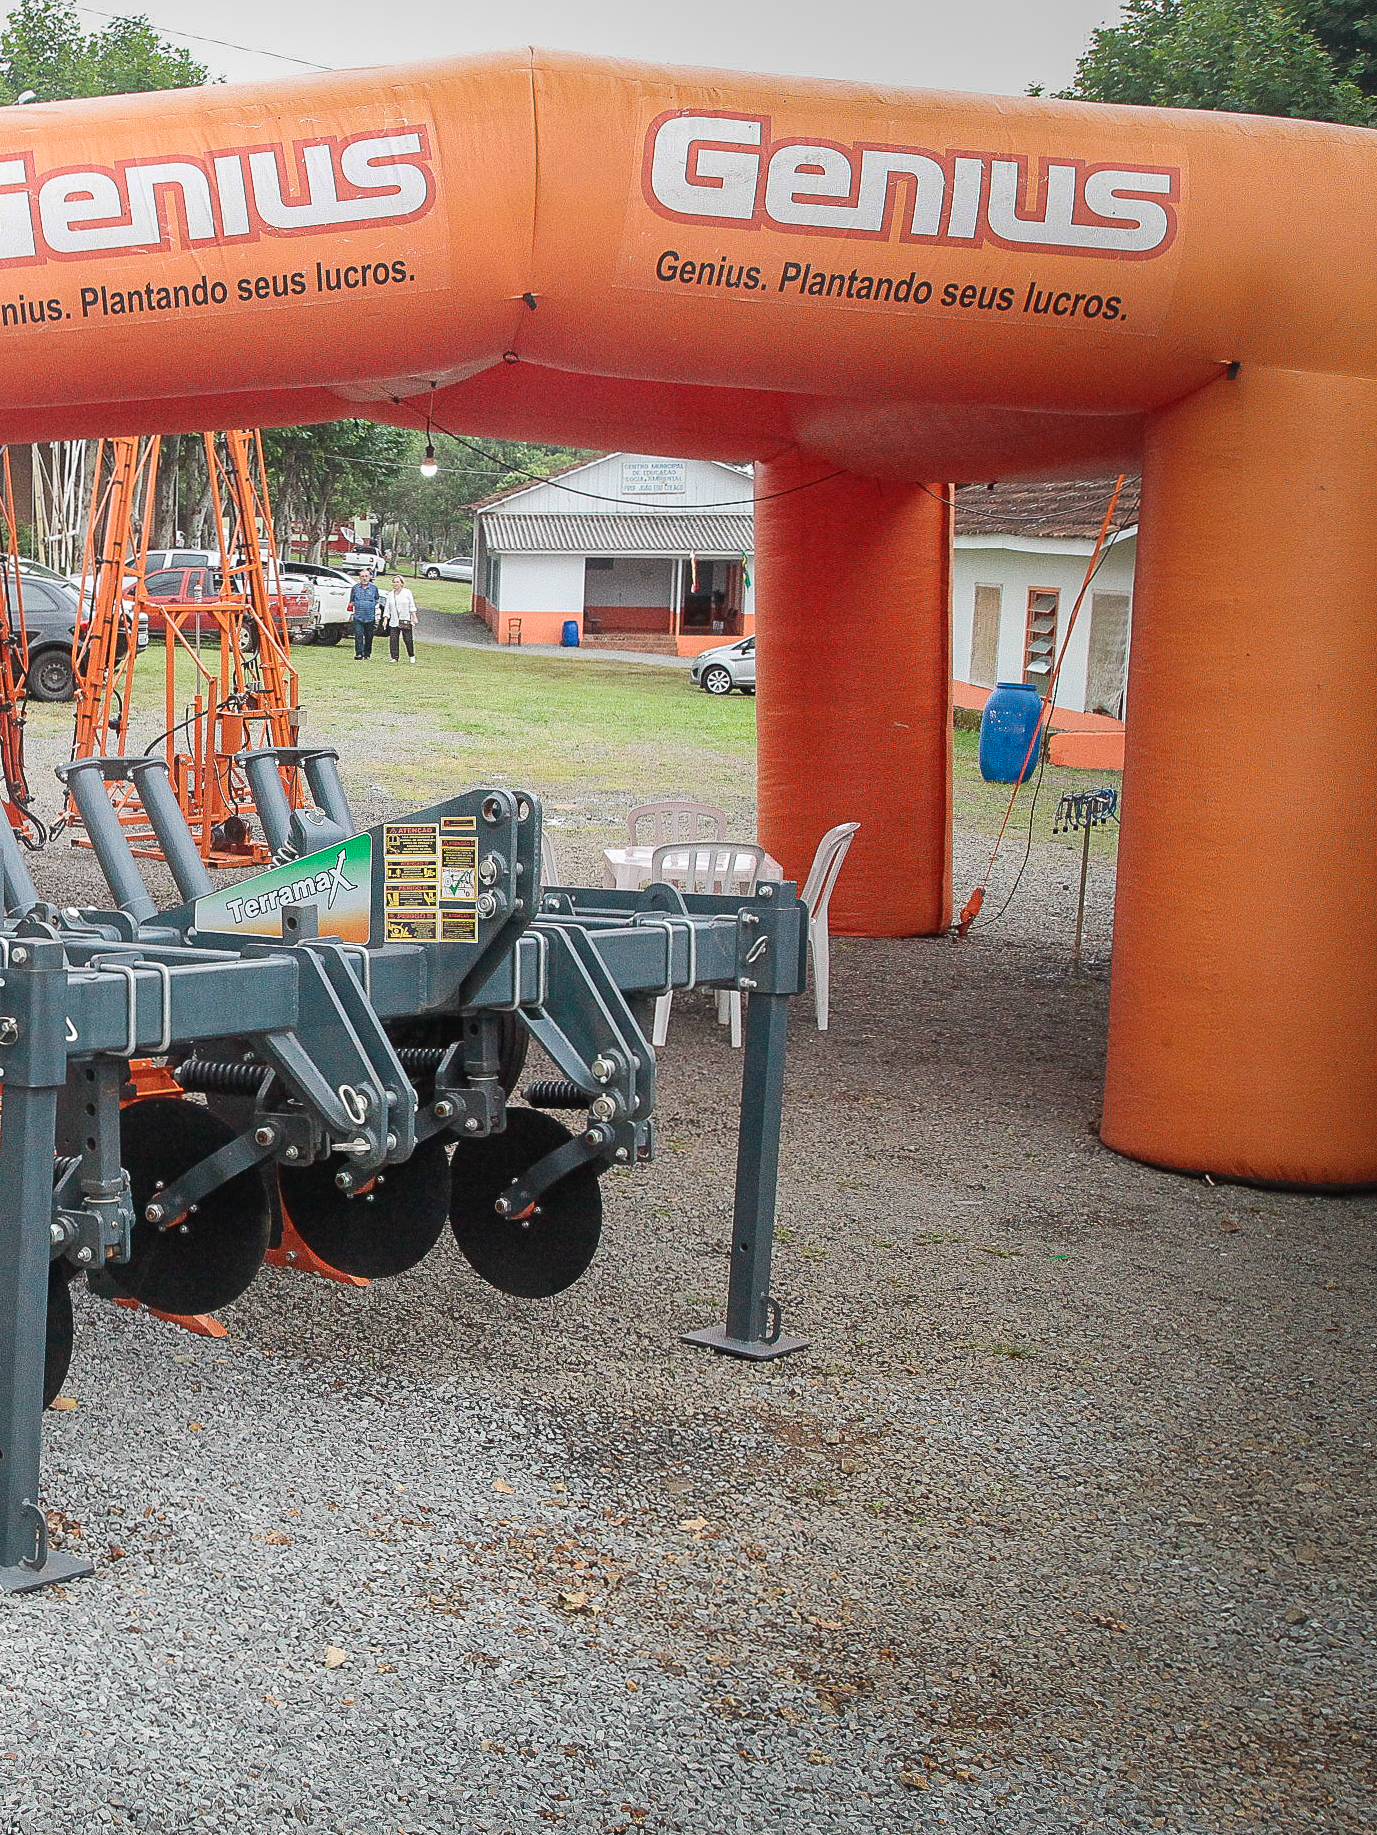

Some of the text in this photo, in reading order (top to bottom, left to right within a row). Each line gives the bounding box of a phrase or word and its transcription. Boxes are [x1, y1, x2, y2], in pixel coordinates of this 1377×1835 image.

[641, 108, 1181, 262] Genius
[81, 275, 228, 318] Plantando
[237, 272, 307, 302] seus
[315, 260, 415, 292] lucros.
[654, 249, 1127, 321] Genius. Plantando seus lucros.
